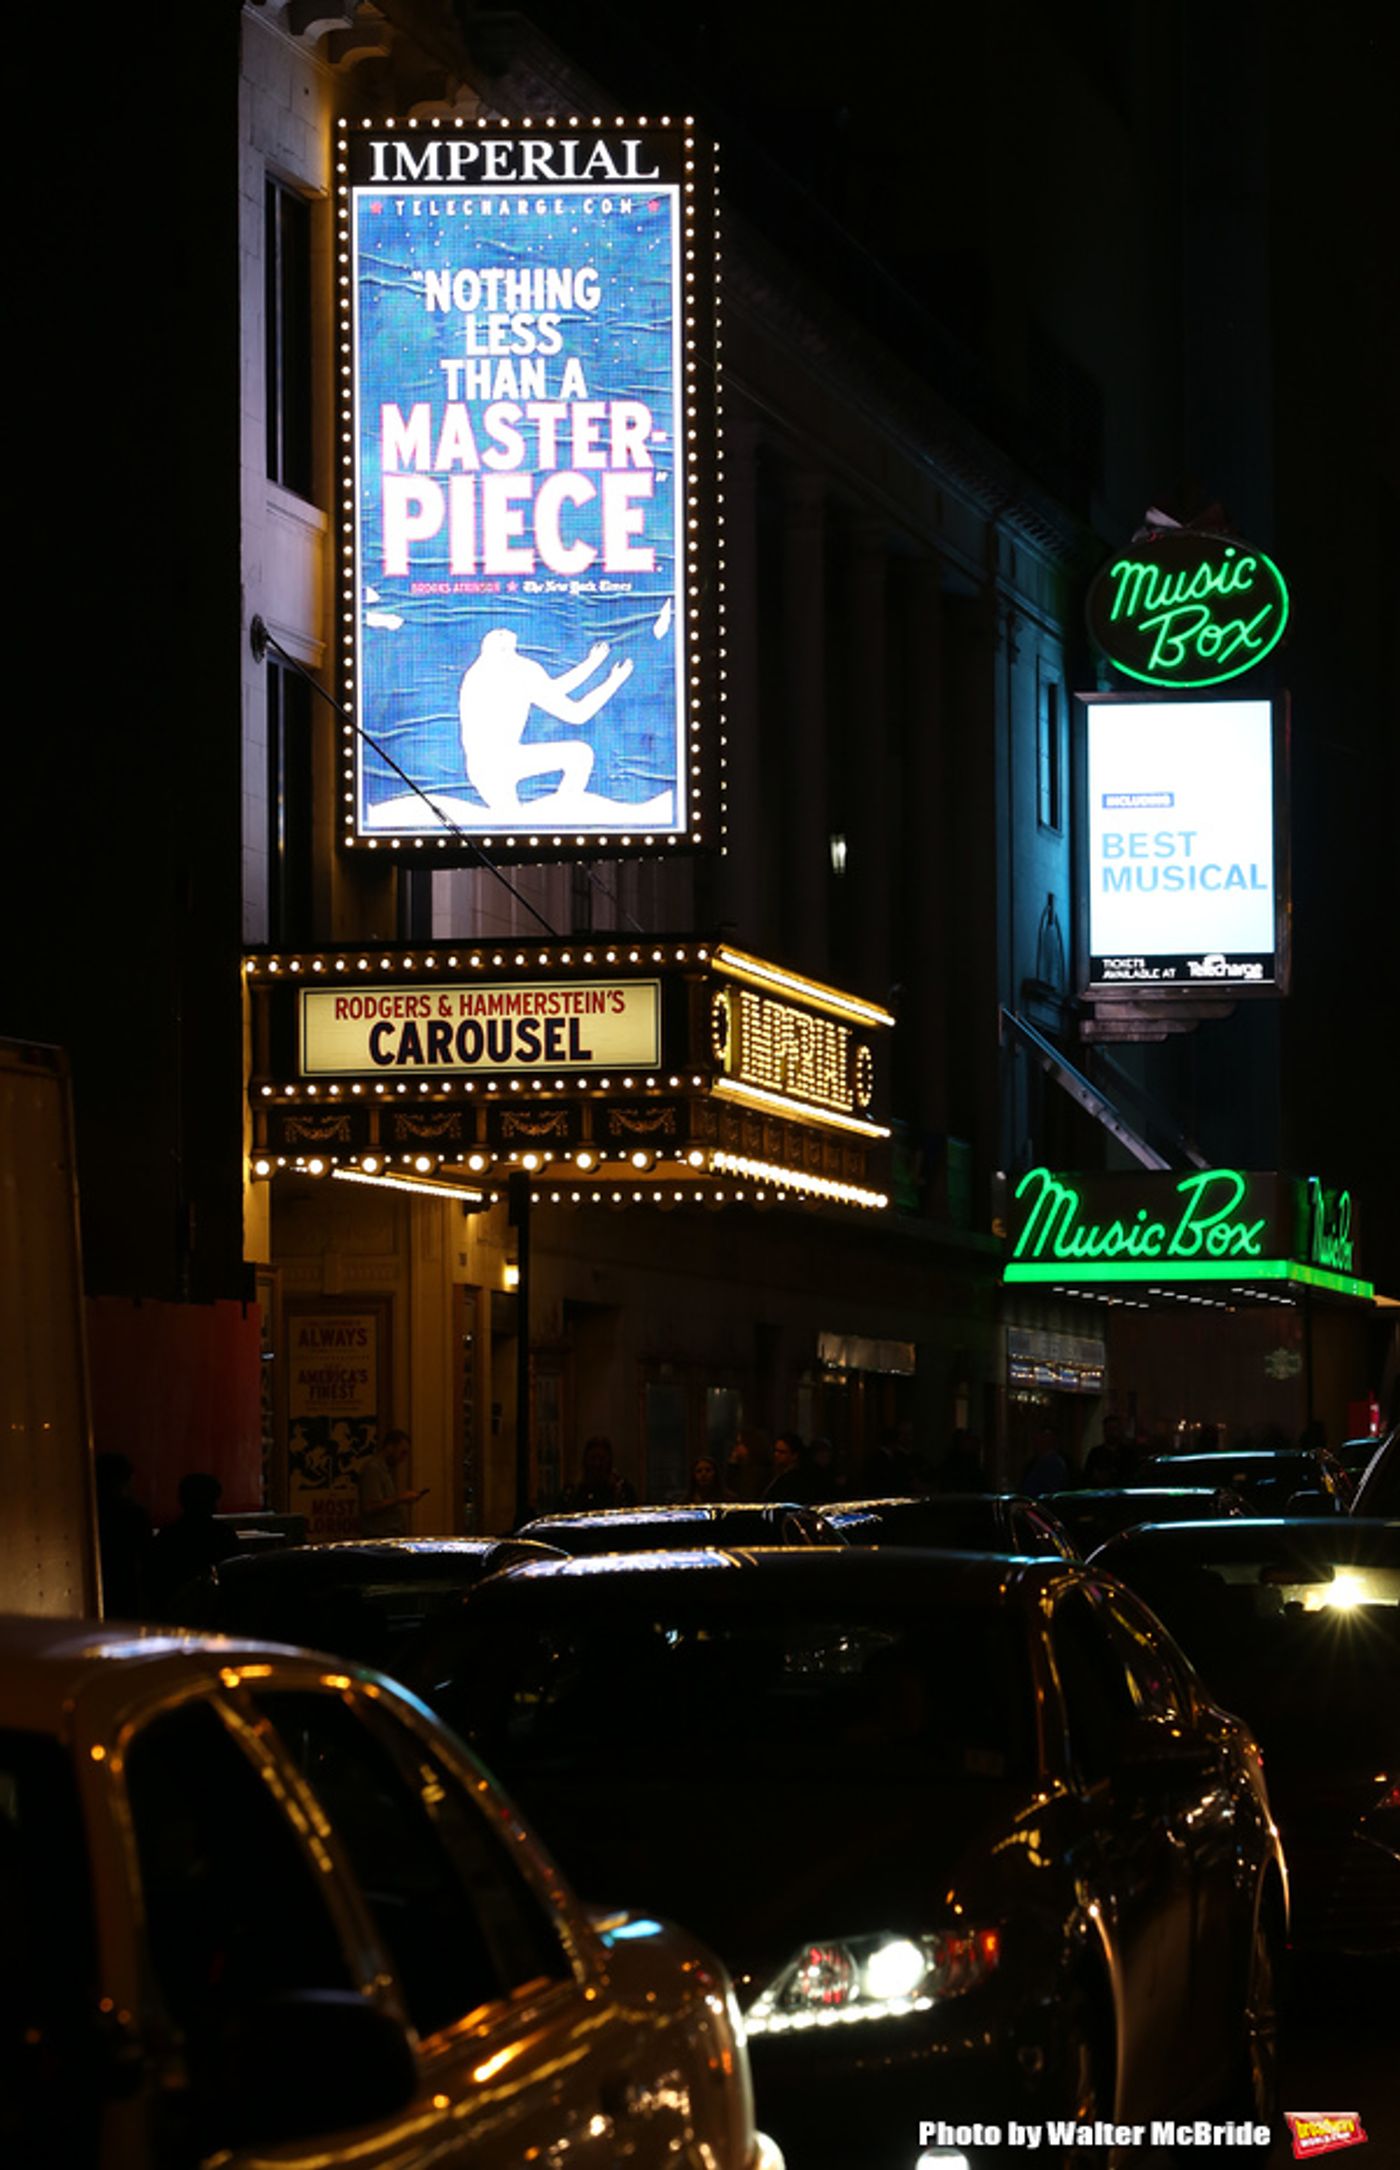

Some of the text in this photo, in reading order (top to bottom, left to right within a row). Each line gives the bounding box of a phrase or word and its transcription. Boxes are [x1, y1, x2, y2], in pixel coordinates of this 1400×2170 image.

[369, 139, 660, 182] IMPERIAL
[395, 199, 634, 217] TELECHARGE.COM
[465, 313, 564, 356] LESS
[440, 358, 589, 401] THAN A
[380, 401, 668, 471] MASTER-
[1110, 547, 1257, 621] Music
[1138, 604, 1273, 670] Box
[1102, 831, 1197, 859] BEST
[1102, 863, 1269, 893] MUSICAL
[1162, 968, 1176, 979] AT
[334, 990, 626, 1019] RODGERS & HAMMERSTEIN'S
[368, 1018, 592, 1066] CAROUSEL
[1014, 1167, 1265, 1258] Music Box
[299, 1328, 367, 1347] ALWAYS
